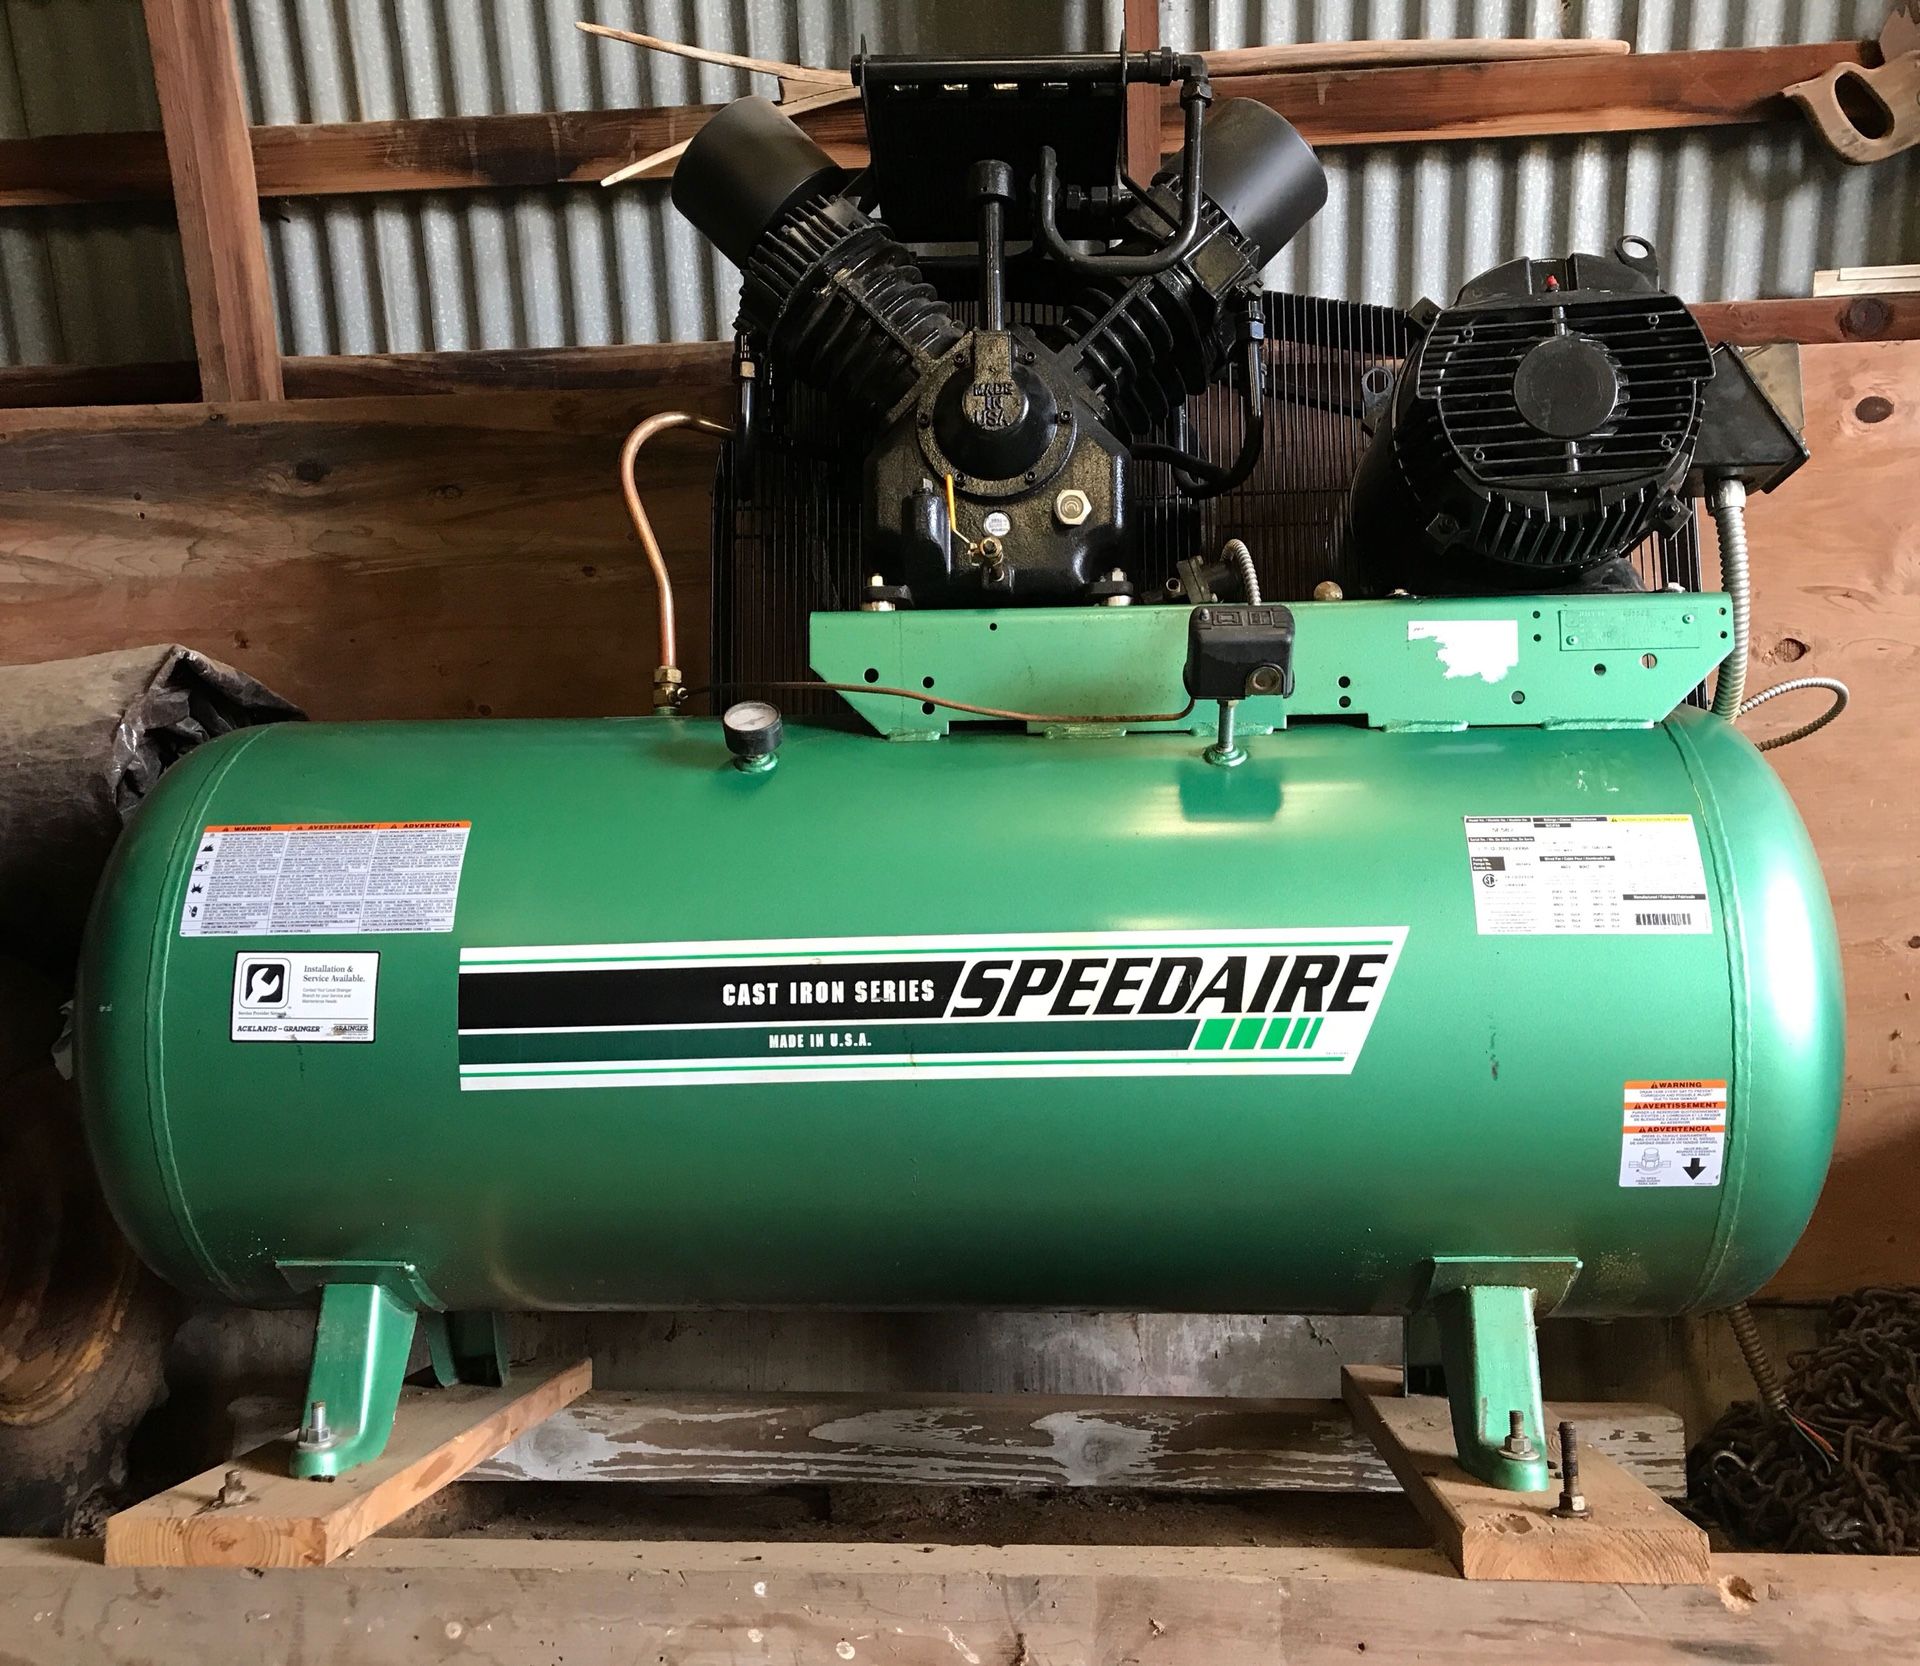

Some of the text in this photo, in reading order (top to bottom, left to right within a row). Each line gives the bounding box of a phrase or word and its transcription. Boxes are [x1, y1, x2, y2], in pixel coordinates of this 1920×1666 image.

[974, 383, 1013, 397] MADE
[985, 396, 1003, 410] IN
[975, 408, 1010, 426] USA
[303, 974, 366, 982] Service Available.
[949, 954, 1389, 1017] SPEEDAIRE
[722, 979, 935, 1006] CAST IRON SERIES
[769, 1032, 872, 1049] MADE IN U.S.A.
